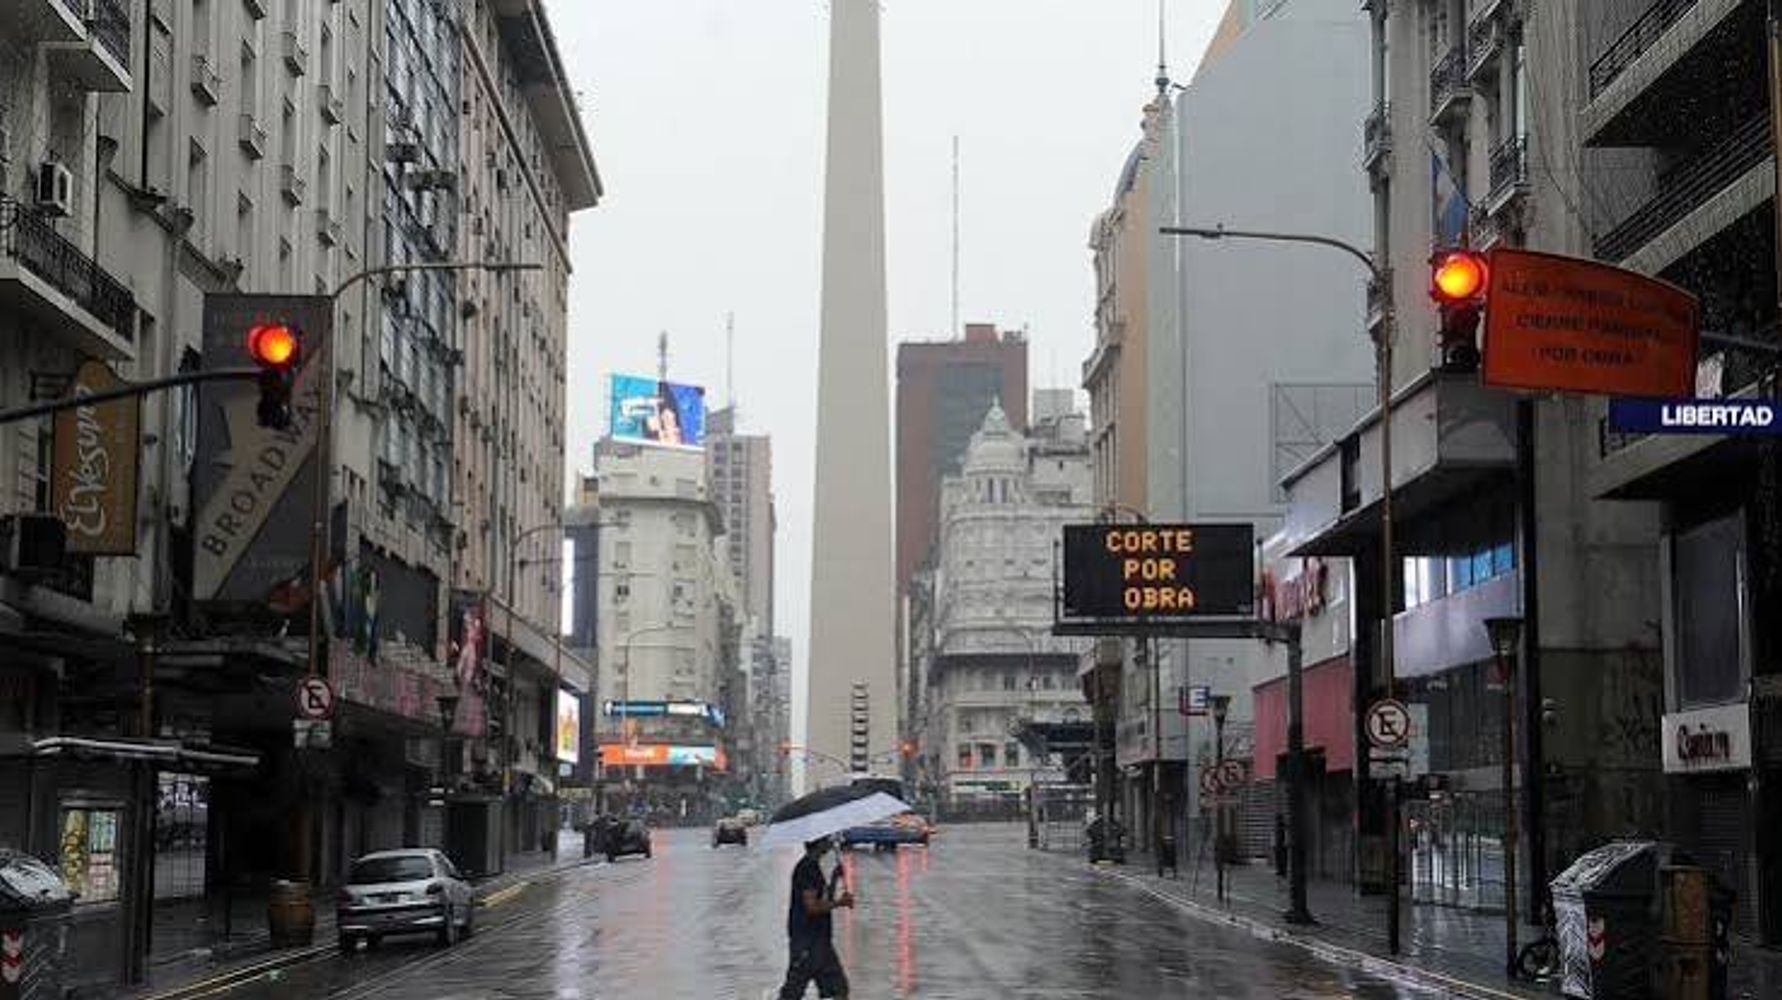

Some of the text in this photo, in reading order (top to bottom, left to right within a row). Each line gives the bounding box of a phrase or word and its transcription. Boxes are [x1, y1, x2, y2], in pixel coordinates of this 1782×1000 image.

[1662, 405, 1774, 427] LIBERTAD
[59, 497, 107, 536] El
[1106, 530, 1193, 553] CORTE
[1124, 558, 1176, 580] POR
[1124, 586, 1195, 609] OBRA
